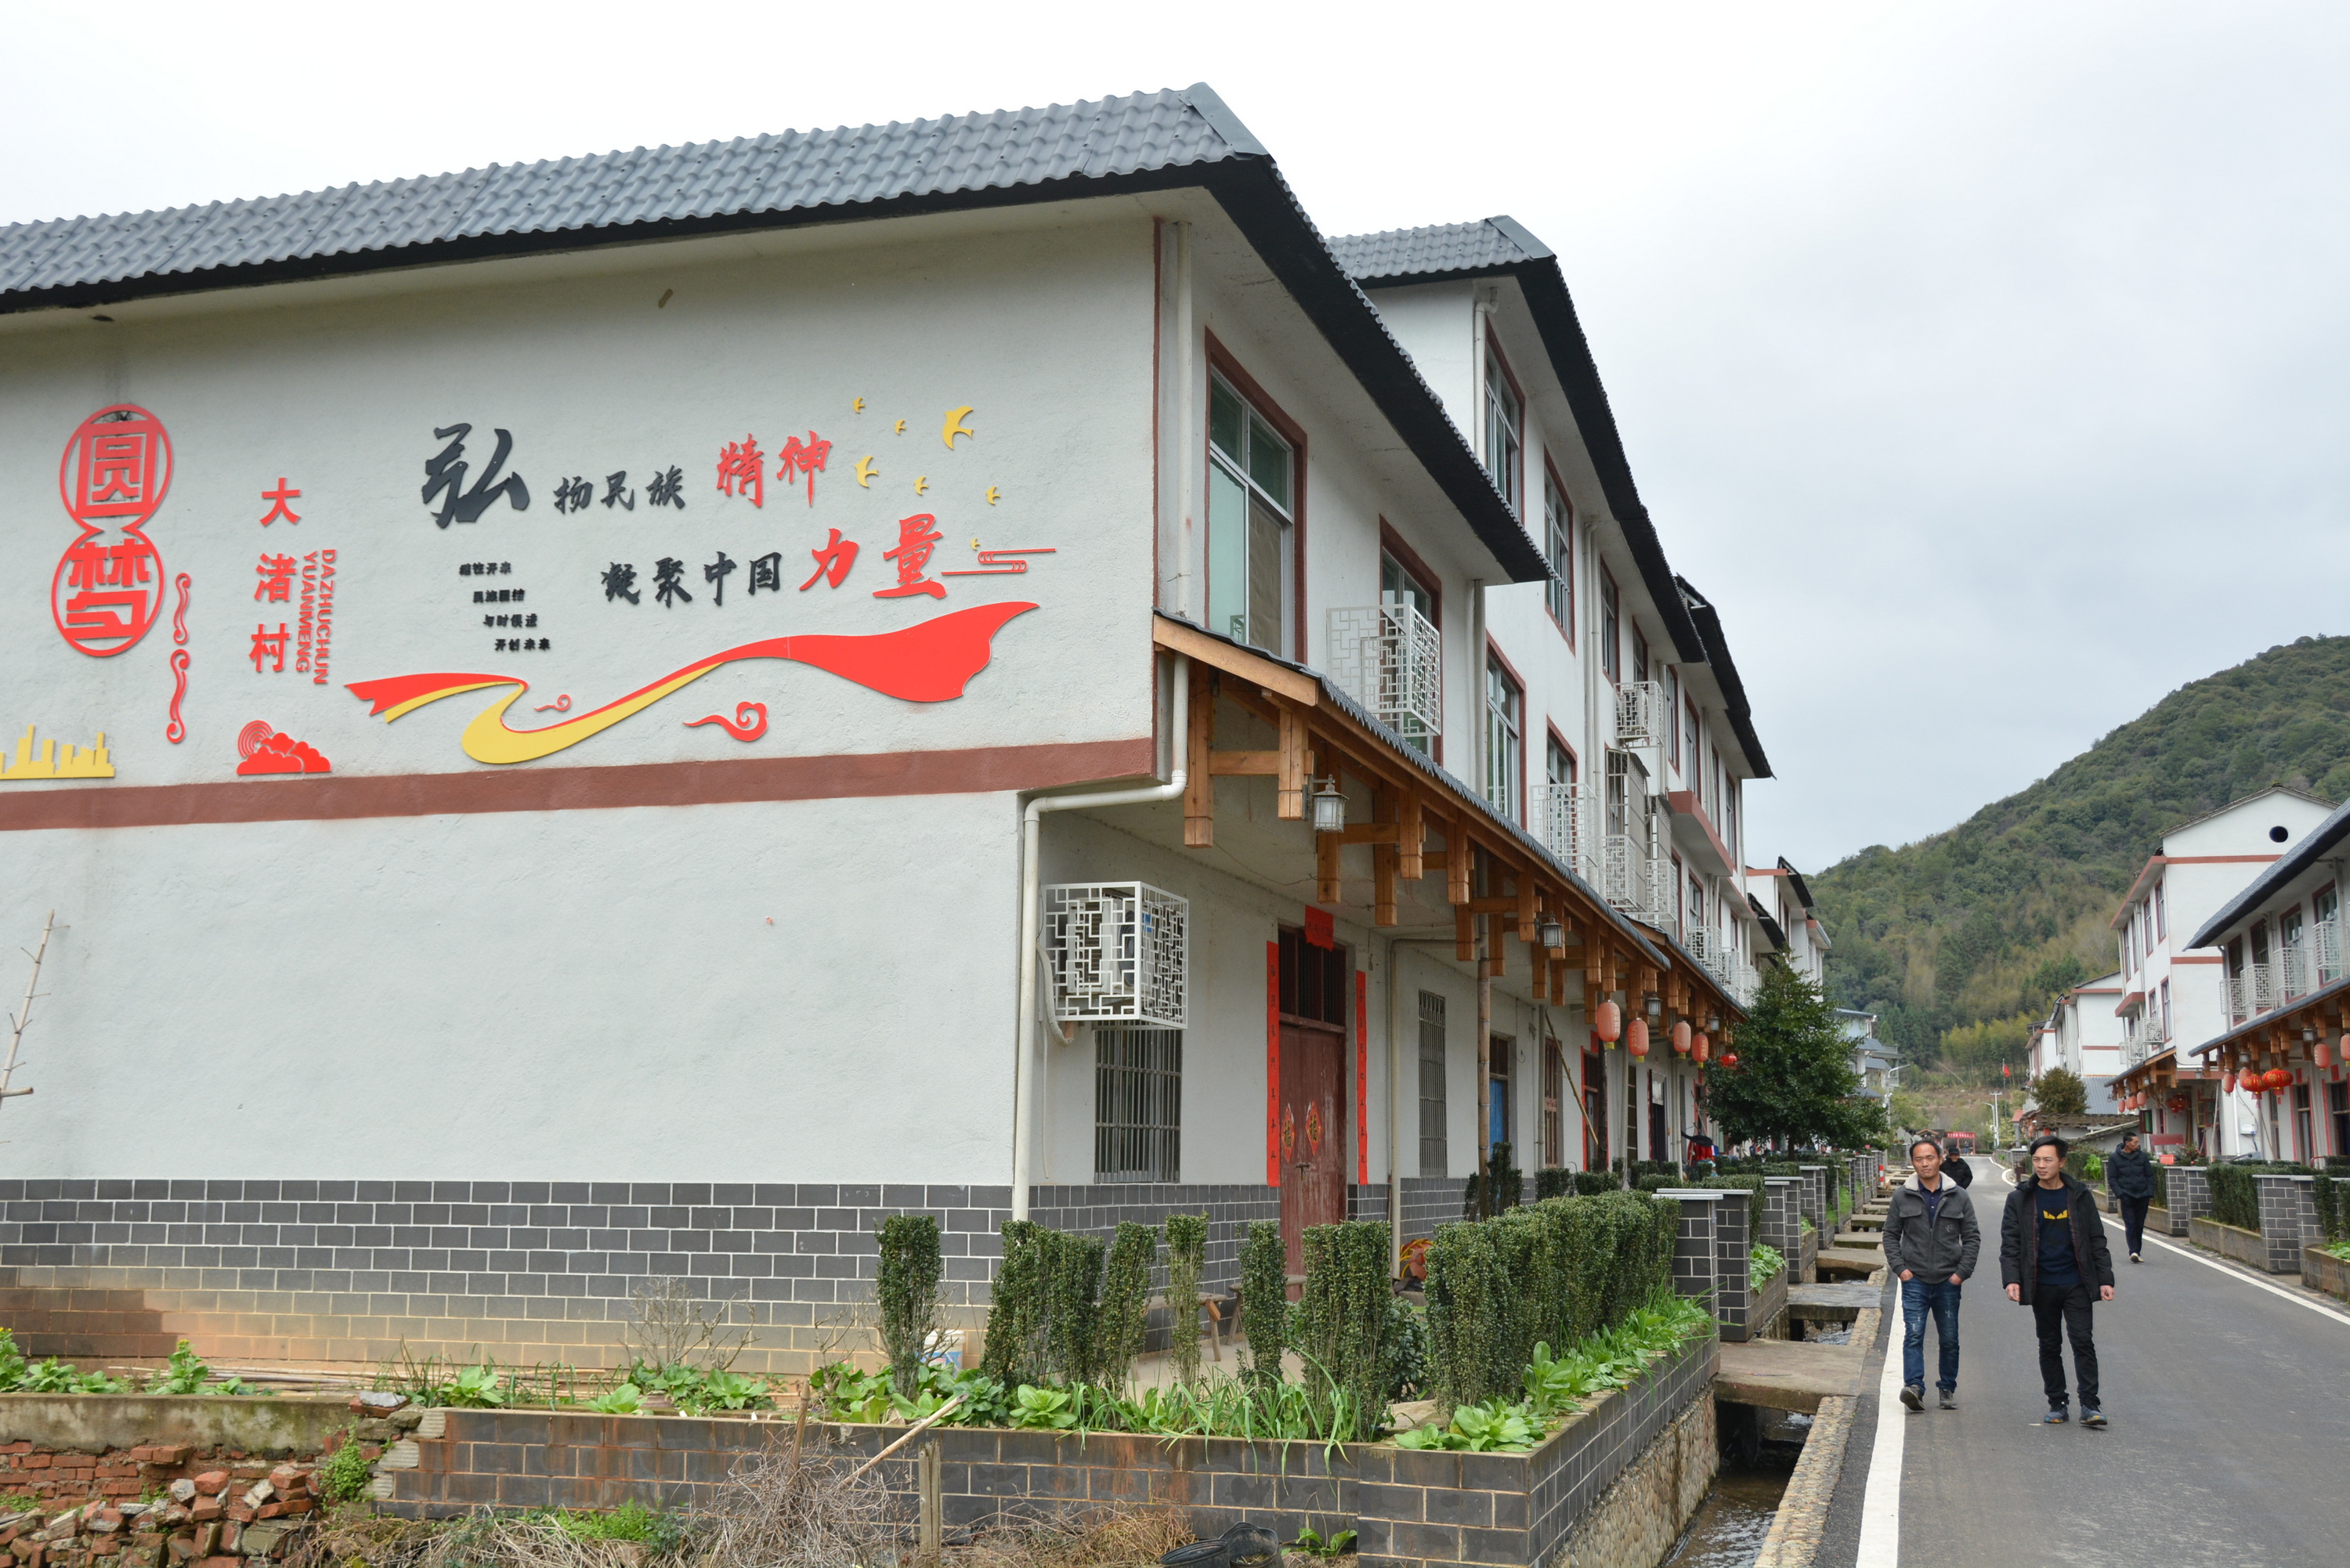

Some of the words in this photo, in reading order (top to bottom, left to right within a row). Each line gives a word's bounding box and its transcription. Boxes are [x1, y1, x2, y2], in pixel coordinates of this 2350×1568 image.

[64, 418, 161, 642] 圆梦
[248, 476, 302, 673] 大渚村
[600, 512, 947, 607] 凝聚中国力量
[295, 550, 318, 673] YUANMENG
[313, 548, 337, 685] DAZHUCHUN
